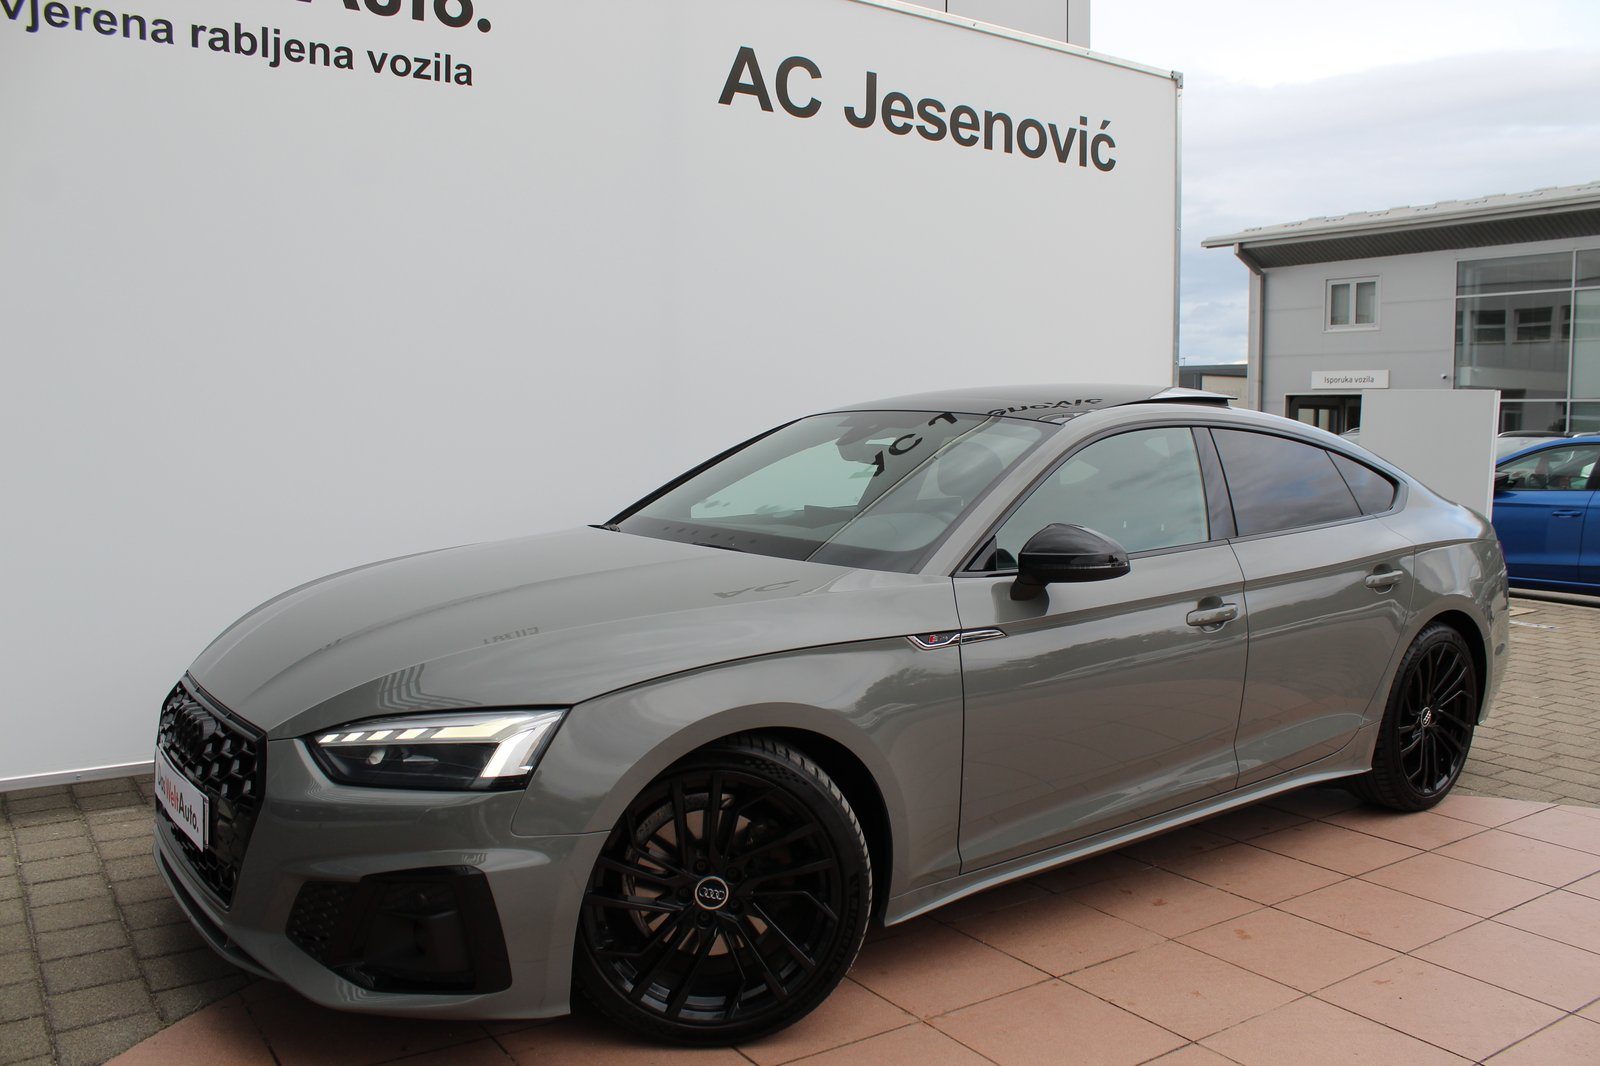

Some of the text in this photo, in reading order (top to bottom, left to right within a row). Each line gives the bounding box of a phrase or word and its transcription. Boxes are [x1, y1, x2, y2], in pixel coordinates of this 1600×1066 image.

[192, 23, 354, 68] rabljena
[366, 51, 473, 87] vozila
[718, 46, 1117, 172] AC Jesenović
[1324, 375, 1375, 385] Isporuka vozila
